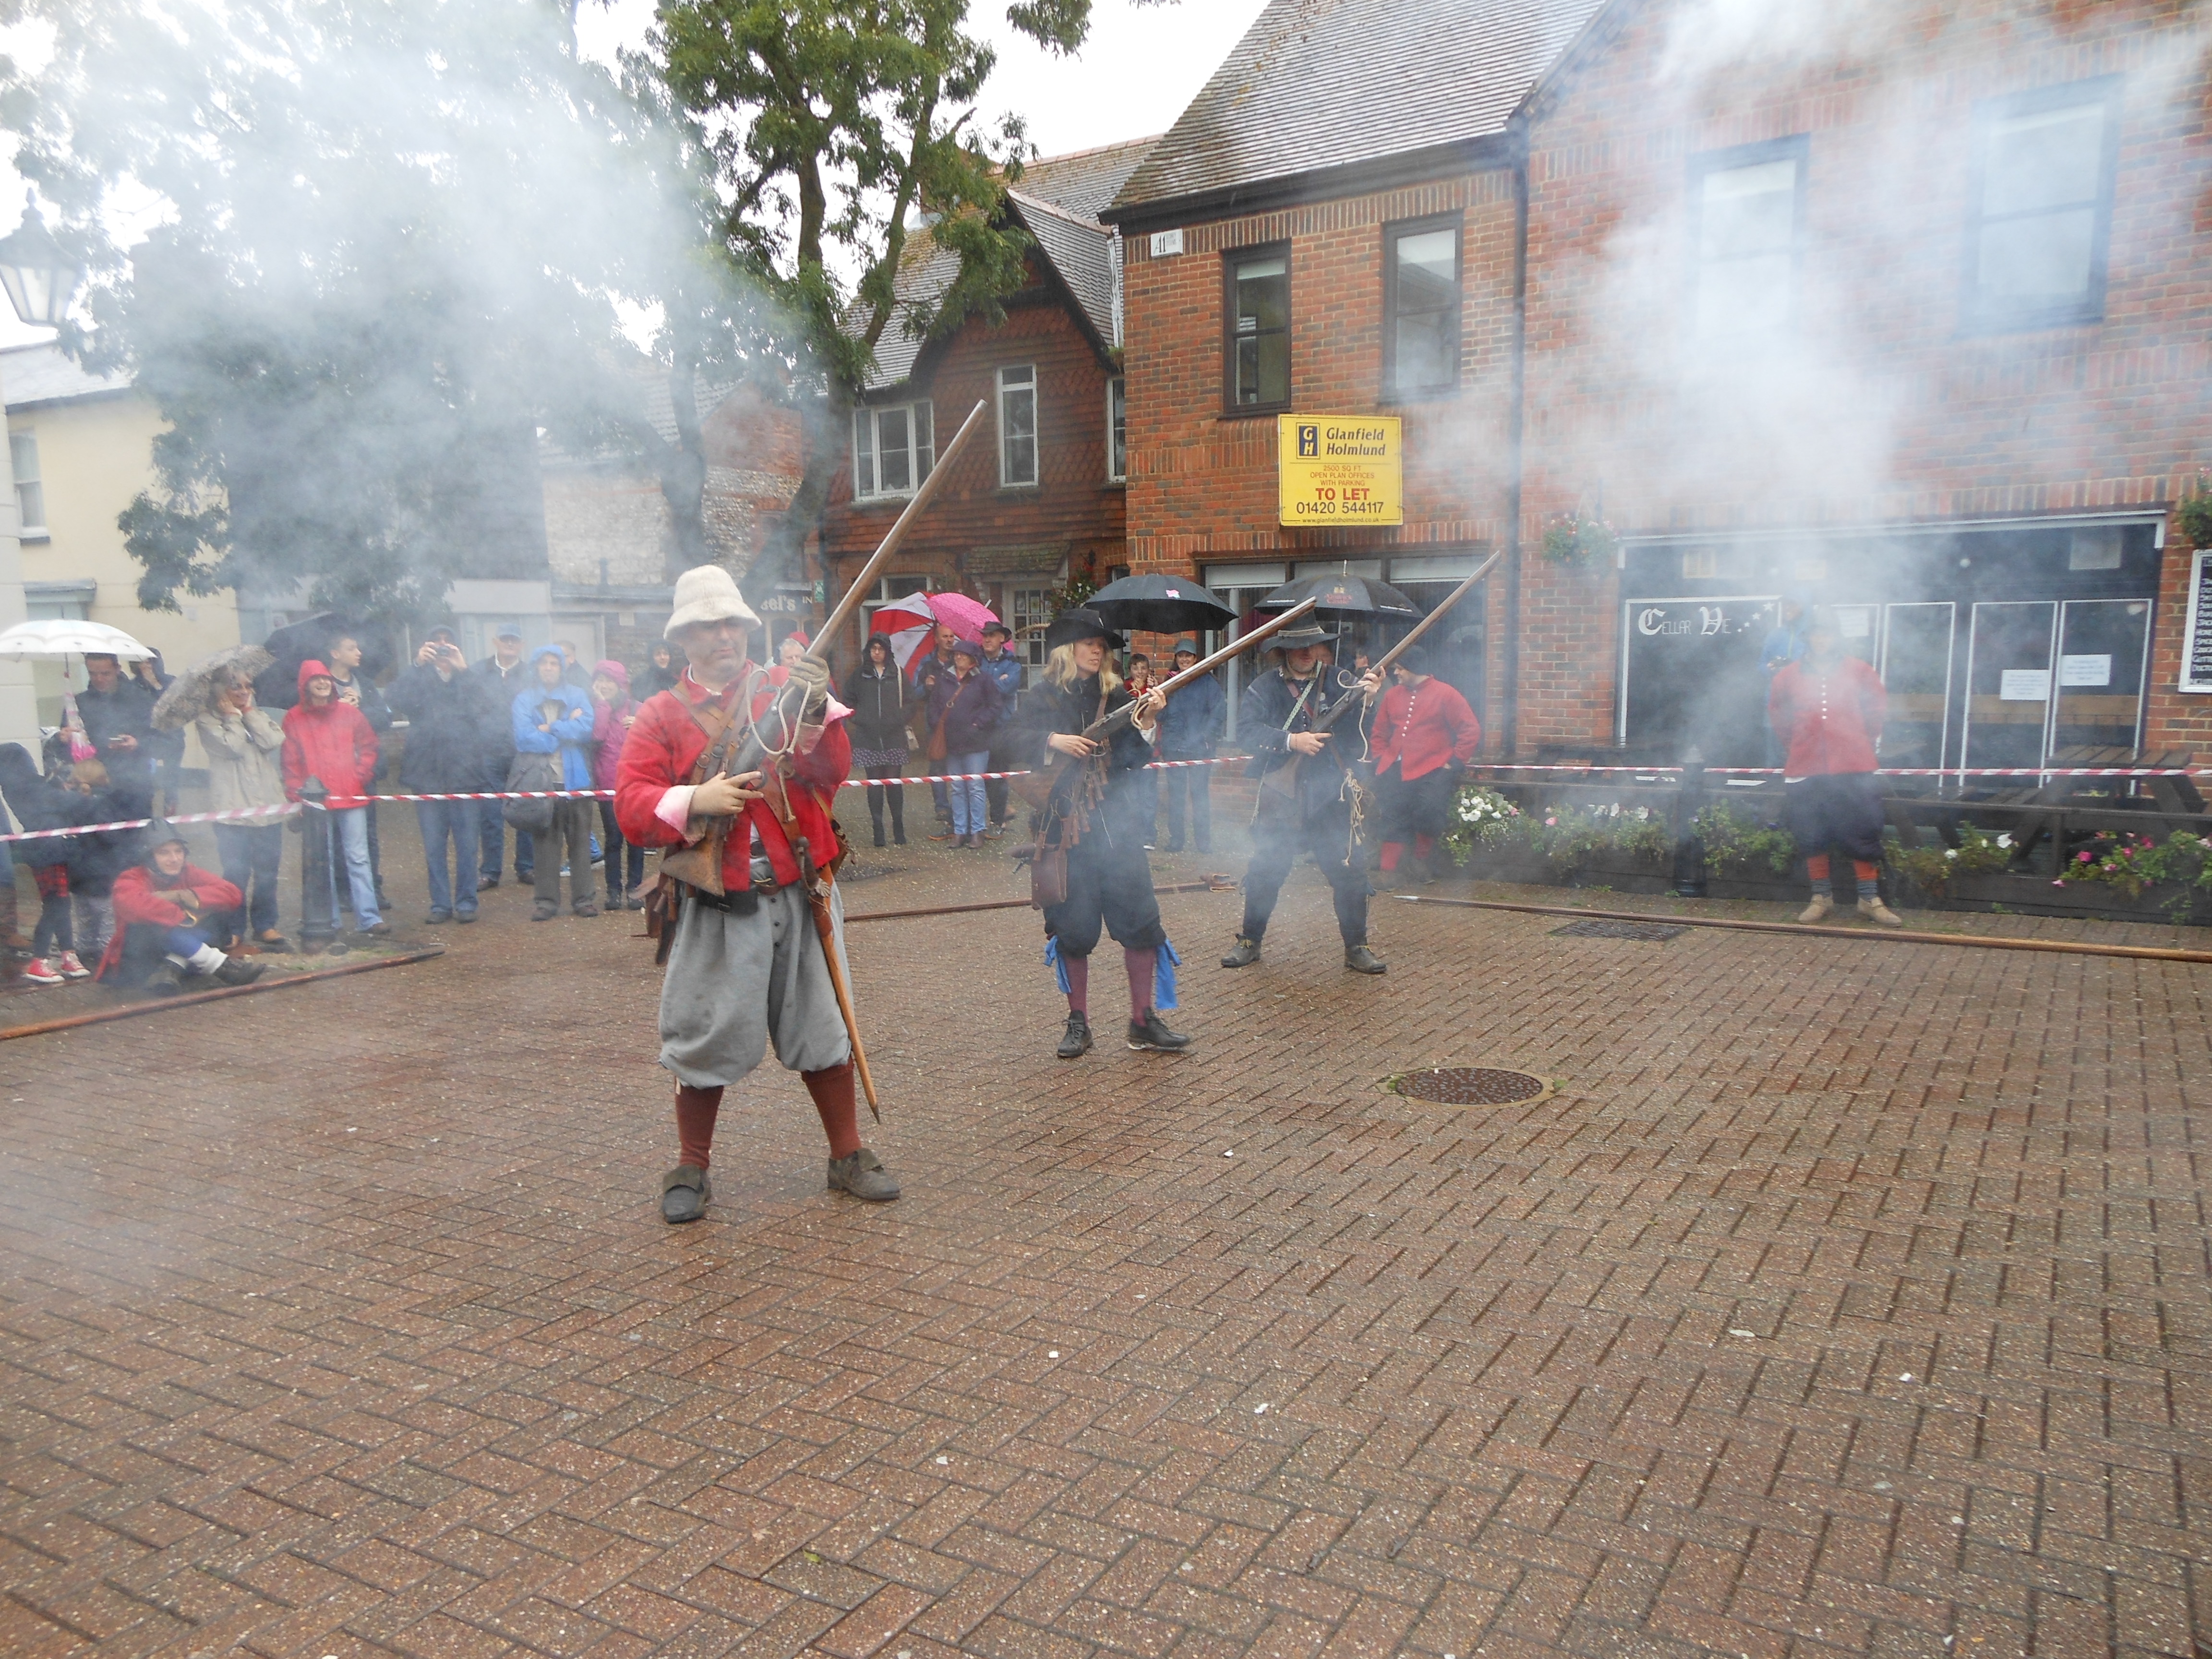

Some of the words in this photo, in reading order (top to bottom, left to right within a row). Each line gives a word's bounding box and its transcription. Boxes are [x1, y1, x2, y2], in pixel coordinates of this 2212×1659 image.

[1303, 427, 1313, 440] G
[1326, 427, 1384, 441] Glanfield
[1303, 442, 1314, 455] H
[1326, 443, 1386, 456] Holmlund
[1315, 487, 1336, 501] TO
[1342, 488, 1370, 501] LET
[1296, 502, 1335, 514] 01420
[1341, 502, 1384, 514] 544117
